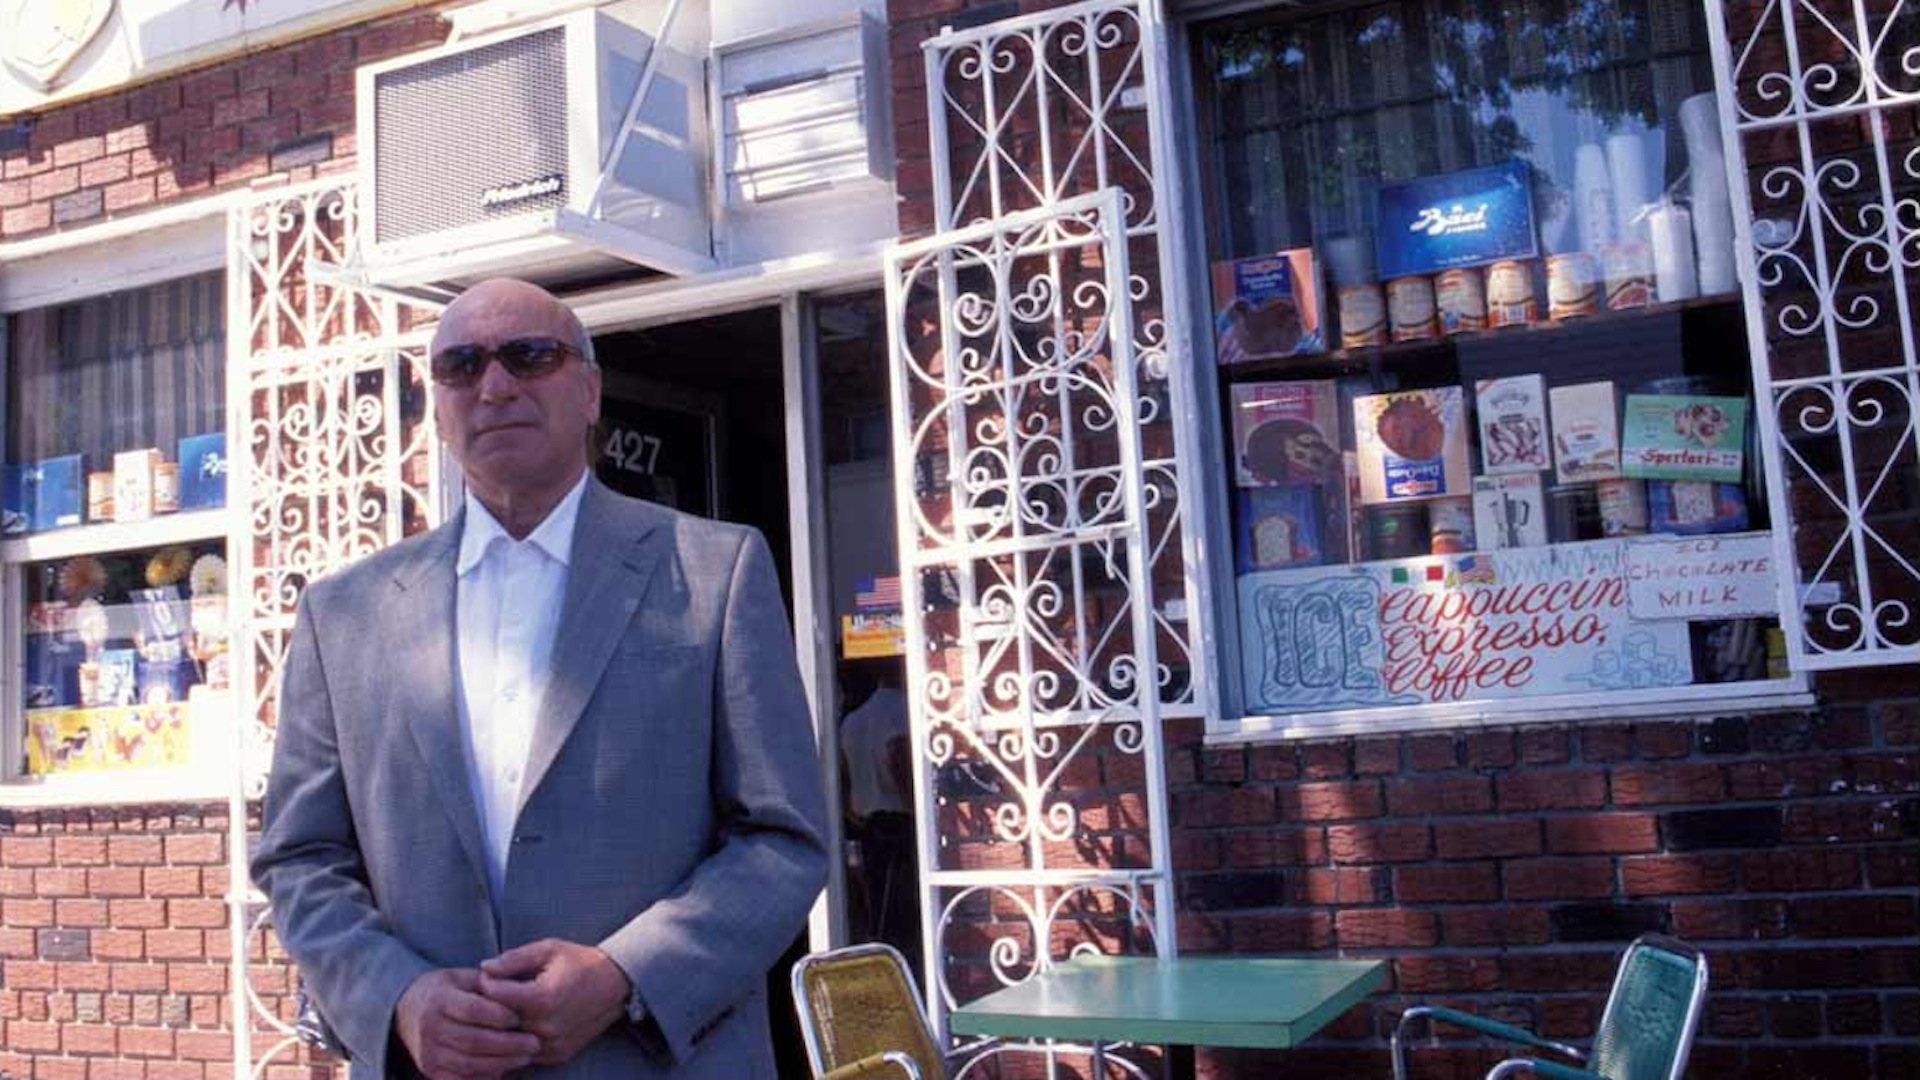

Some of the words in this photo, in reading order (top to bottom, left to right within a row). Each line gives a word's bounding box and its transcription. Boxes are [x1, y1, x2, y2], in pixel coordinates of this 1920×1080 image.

[605, 428, 662, 475] 427
[1658, 584, 1738, 608] MILK
[1262, 590, 1380, 690] ICE
[1381, 651, 1535, 701] Coffee
